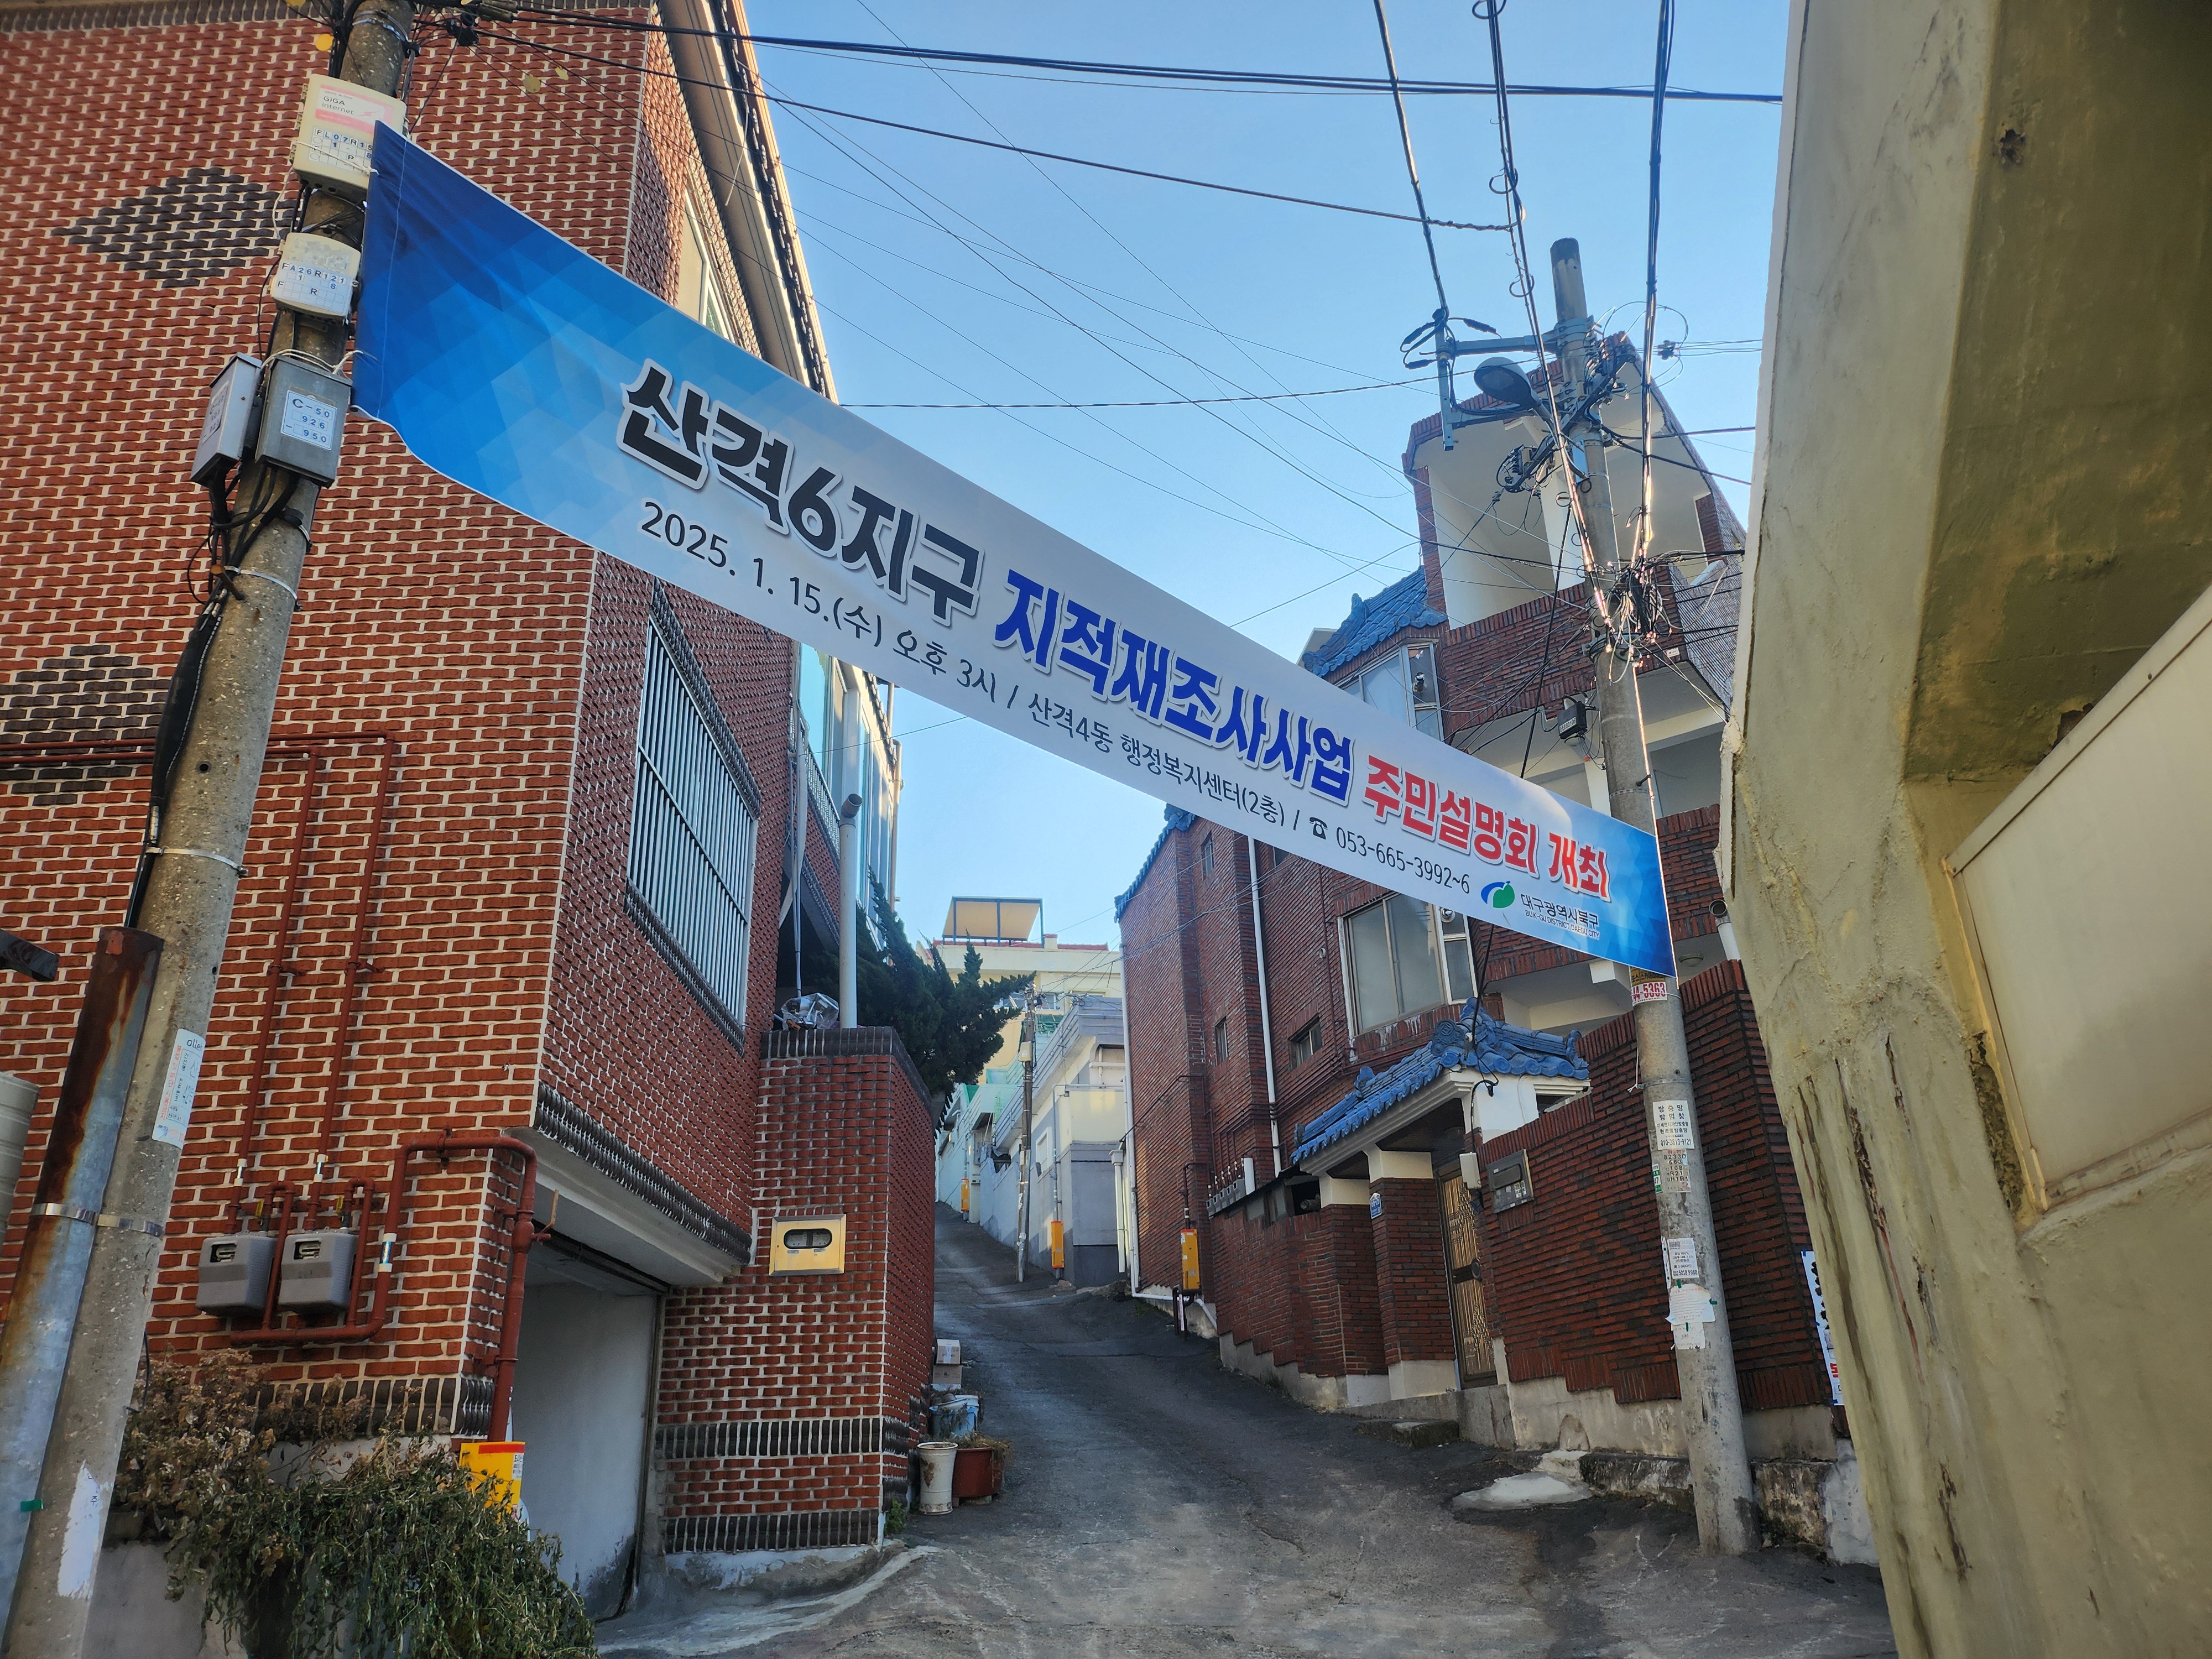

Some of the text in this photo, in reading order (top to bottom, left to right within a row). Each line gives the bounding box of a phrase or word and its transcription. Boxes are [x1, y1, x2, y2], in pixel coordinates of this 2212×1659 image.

[322, 102, 354, 115] internet
[310, 288, 318, 296] R
[302, 415, 325, 429] 926
[620, 363, 1608, 899] 산격6지구 지적재조사사업 주민설명회 개최
[641, 501, 736, 576] 2025.
[752, 557, 774, 595] 1.
[893, 629, 948, 676] 오후
[956, 659, 996, 703] 3시
[1006, 685, 1019, 709] /
[1027, 693, 1113, 754] 산격4동
[1120, 733, 1285, 827] 행정복지센터(2층)
[1293, 809, 1300, 831] /
[1336, 826, 1471, 895] 053-665-3992~6
[1520, 893, 1599, 930] 대구광역시북구
[1525, 909, 1599, 939] BUK-GU DISTRICT DAEGU CITY
